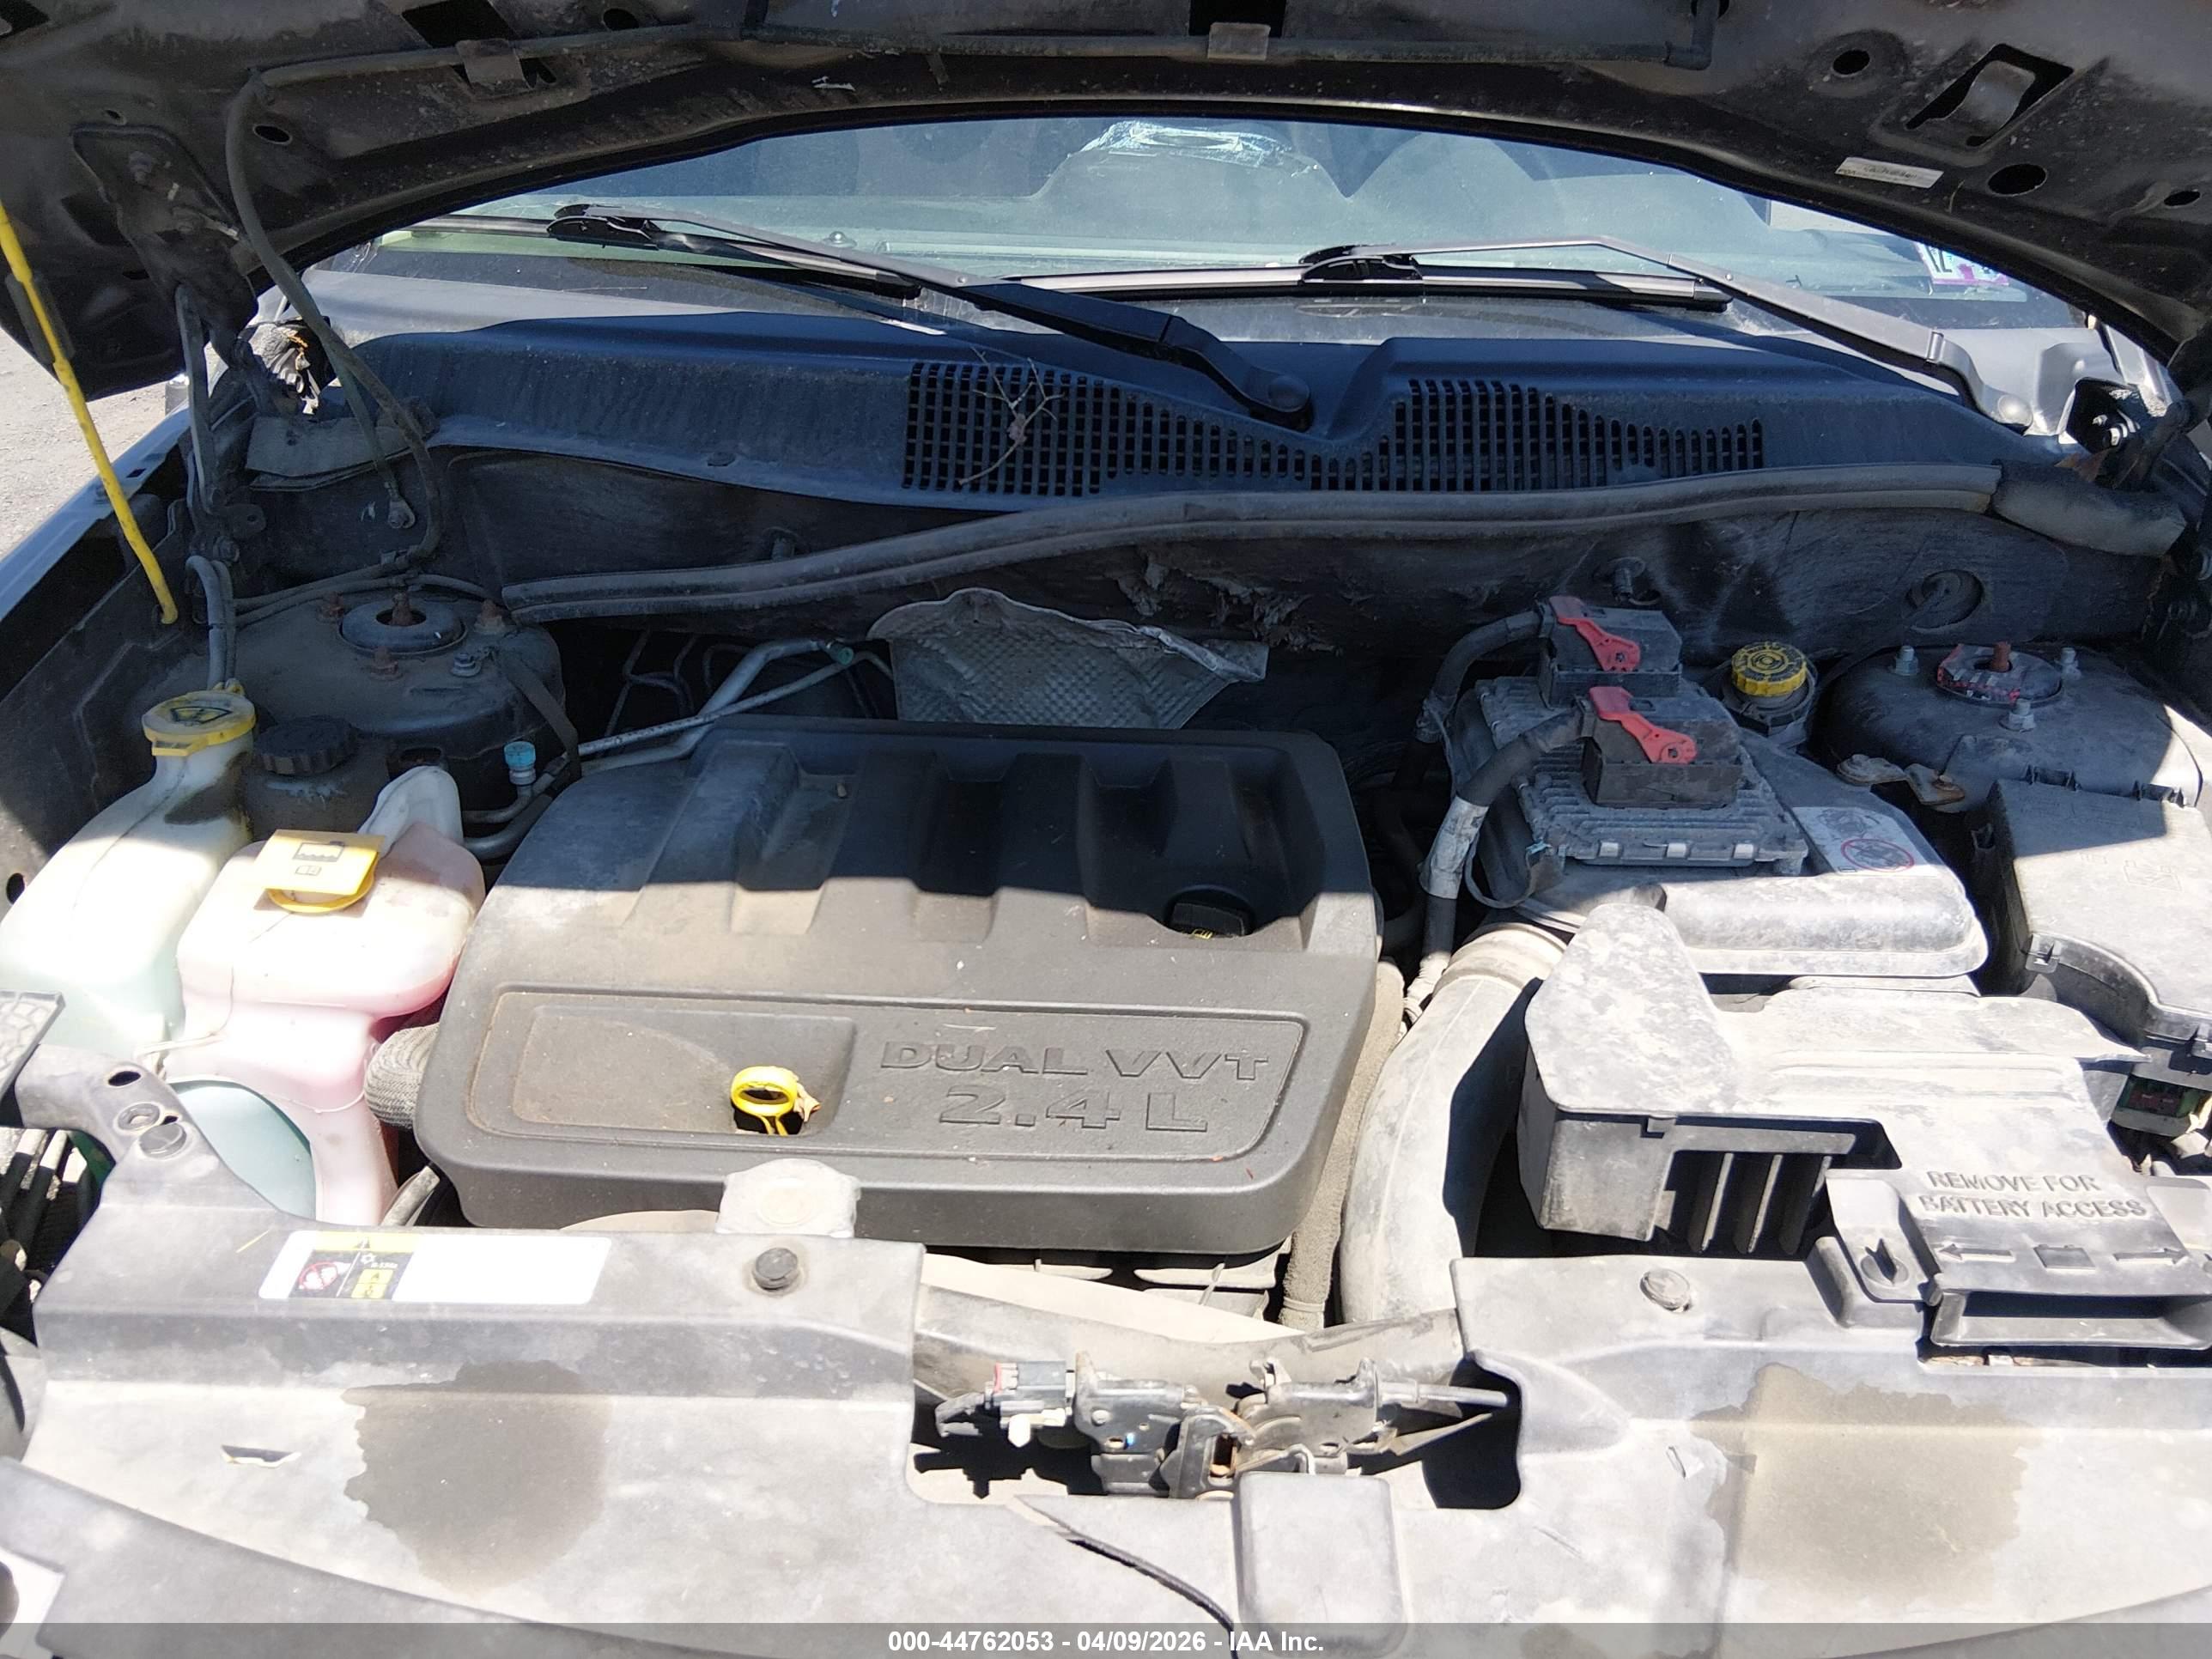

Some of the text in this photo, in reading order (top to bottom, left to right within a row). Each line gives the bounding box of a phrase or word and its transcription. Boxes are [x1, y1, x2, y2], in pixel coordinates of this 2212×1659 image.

[880, 1041, 1268, 1081] DUAL VVT
[1926, 1170, 2101, 1193] REMOVE FOR
[1917, 1194, 2148, 1218] BATTERY ACCESS
